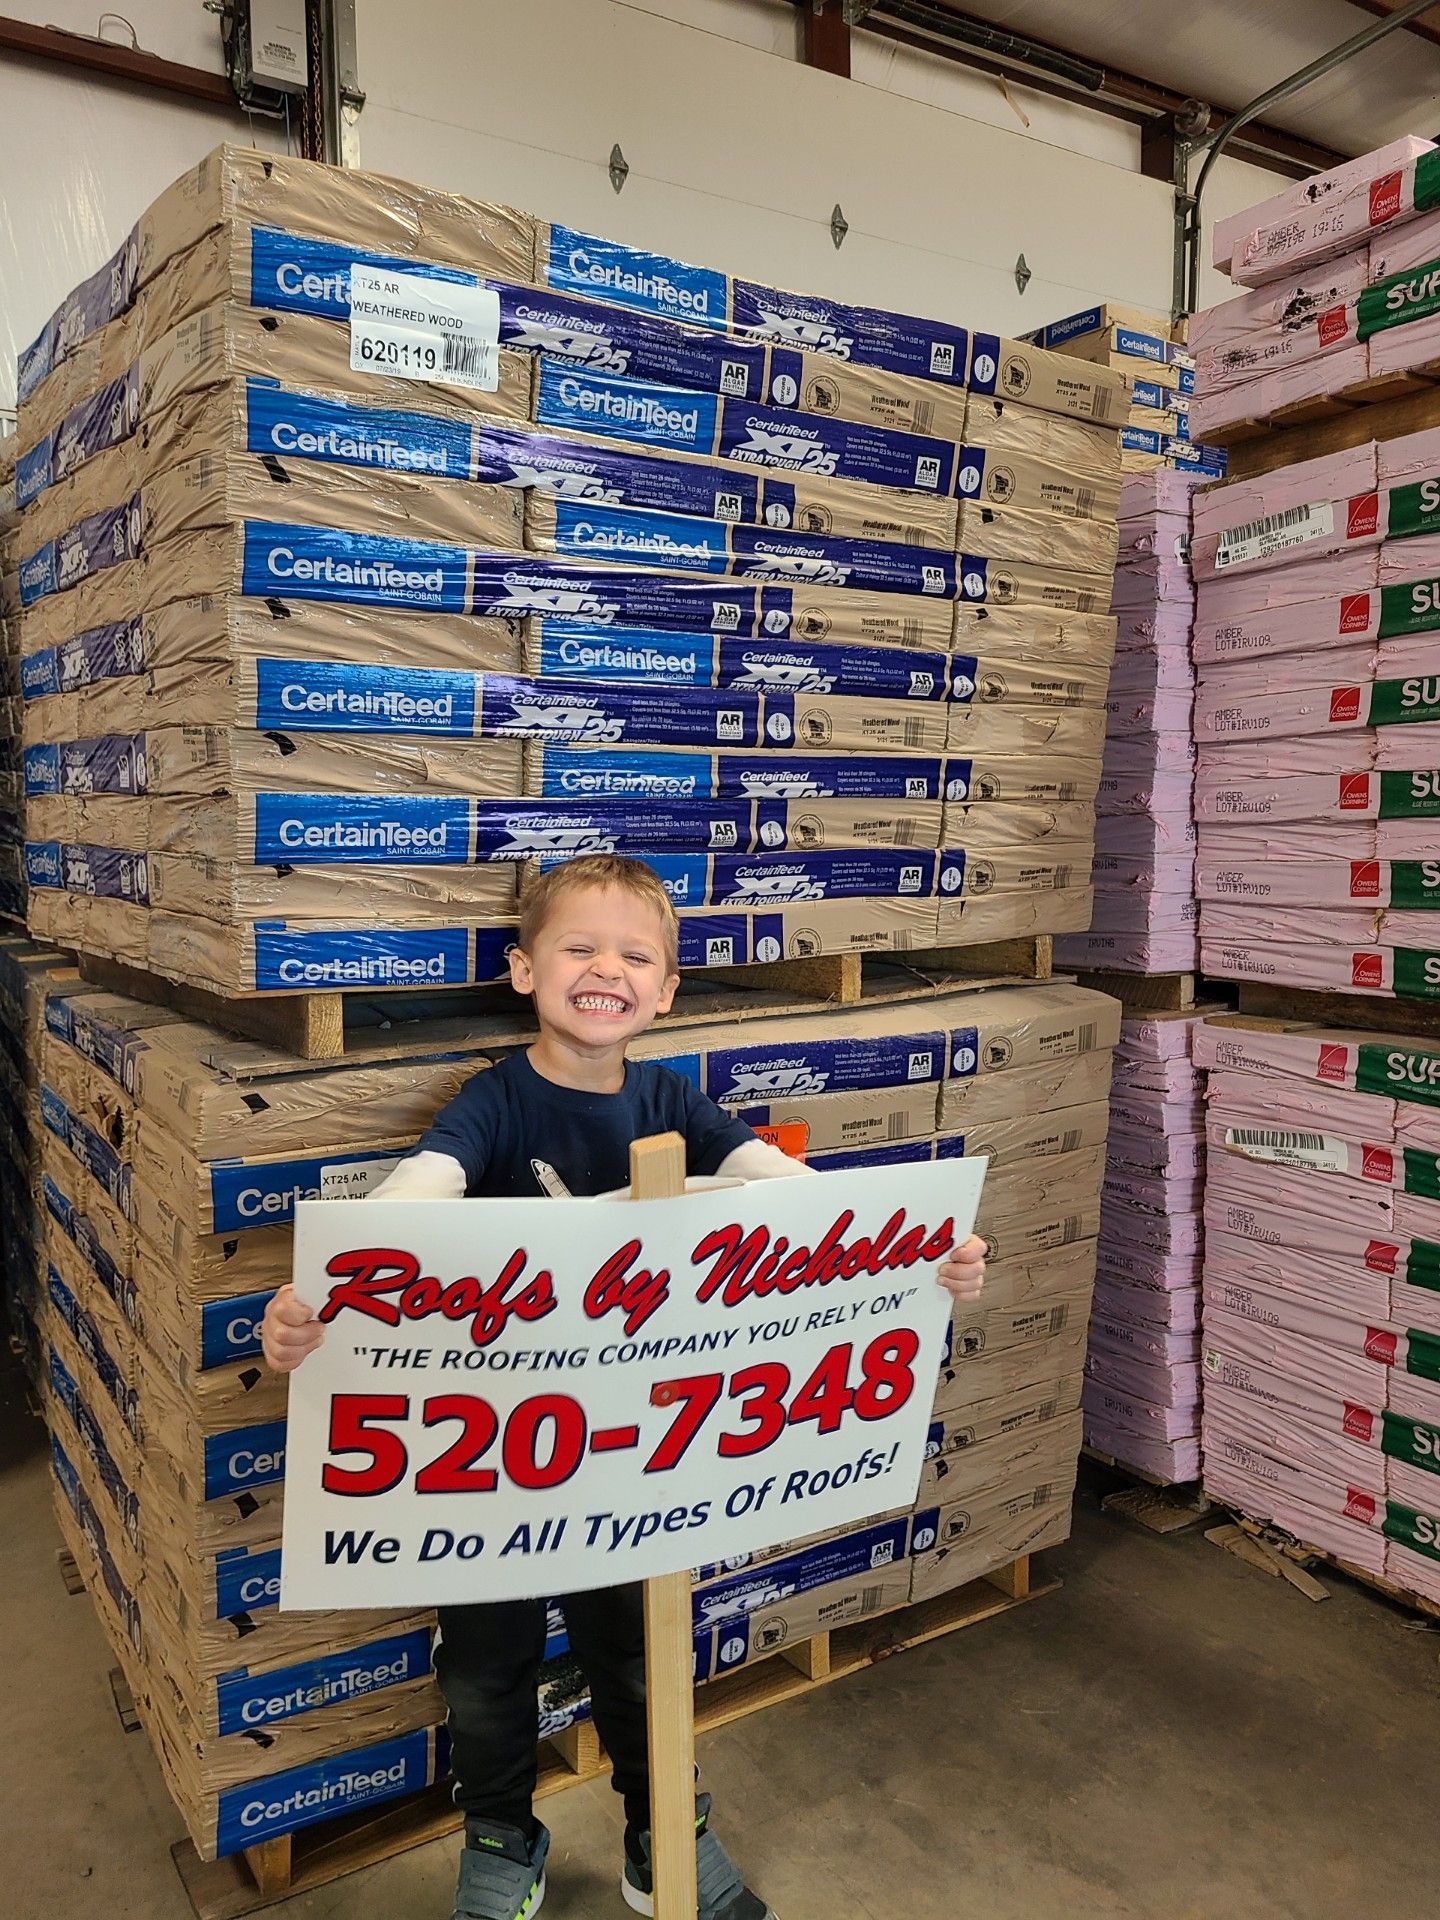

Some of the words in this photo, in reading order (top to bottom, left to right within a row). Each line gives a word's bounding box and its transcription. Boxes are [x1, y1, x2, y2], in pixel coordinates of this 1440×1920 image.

[1372, 201, 1398, 220] CORNING
[384, 283, 400, 294] AR
[569, 251, 708, 313] CertainTeed
[353, 300, 425, 322] WEATHERED
[428, 314, 463, 328] WOOD
[757, 300, 830, 324] CertainTeed
[515, 306, 605, 335] CertainTeed
[362, 338, 435, 369] 620119
[934, 347, 952, 359] AR
[1121, 338, 1160, 355] CertainTeed
[724, 363, 746, 380] AR
[559, 378, 698, 433] CertainTeed
[745, 416, 818, 439] CertainTeed
[271, 422, 447, 471] CertainTeed
[507, 449, 597, 475] CertainTeed
[729, 448, 765, 464] EXTRA
[763, 455, 802, 471] TOUGH
[919, 460, 937, 473] AR
[718, 496, 739, 510] AR
[1349, 522, 1376, 534] CORNING
[1355, 515, 1376, 526] OWENS
[574, 523, 709, 558] CertainTeed
[754, 542, 824, 558] CertainTeed
[660, 556, 709, 566] SAINT-GOBAIN
[267, 548, 443, 592] CertainTeed
[924, 570, 942, 581] AR
[503, 572, 592, 591] CertainTeed
[378, 587, 442, 602] SAINT-GOBAIN
[717, 605, 737, 618] AR
[1342, 620, 1367, 629] CORNING
[1215, 627, 1243, 640] AMBER
[560, 639, 696, 674] CertainTeed
[741, 652, 813, 666] CertainTeed
[914, 673, 931, 685] AR
[281, 684, 452, 717] CertainTeed
[510, 693, 598, 708] CertainTeed
[1215, 709, 1243, 721] AMBER
[1332, 710, 1357, 719] CORNING
[1337, 705, 1358, 713] OWENS
[719, 713, 741, 727] AR
[886, 718, 900, 726] Wood
[561, 770, 696, 795] CertainTeed
[740, 771, 810, 783] CertainTeed
[908, 780, 925, 792] AR
[1216, 792, 1244, 802] AMBER
[505, 816, 593, 828] CertainTeed
[714, 822, 735, 836] AR
[279, 819, 447, 847] CertainTeed
[386, 846, 446, 855] SAINT-GOBAIN
[735, 864, 806, 877] CertainTeed
[903, 869, 920, 881] AR
[1216, 872, 1244, 883] AMBER
[709, 938, 730, 953] AR
[279, 953, 445, 982] CertainTeed
[1354, 976, 1381, 984] CORNING
[1216, 1042, 1244, 1055] AMBER
[730, 1056, 805, 1075] CertainTeed
[911, 1053, 930, 1067] AR
[1320, 1069, 1345, 1078] CORNING
[750, 1089, 790, 1100] TOUGH
[867, 1117, 883, 1127] Wood
[322, 1174, 349, 1186] XT25
[352, 1172, 368, 1182] AR
[1365, 1166, 1391, 1178] CORNING
[1227, 1206, 1255, 1225] AMBER
[318, 1248, 558, 1347] Roofs
[584, 1238, 669, 1337] by
[691, 1208, 955, 1307] Nicholas
[1225, 1287, 1253, 1303] AMBER
[441, 1348, 587, 1372] ROOFING
[598, 1328, 739, 1364] COMPANY
[748, 1315, 800, 1344] YOU
[805, 1300, 871, 1332] RELY
[1223, 1362, 1251, 1381] AMBER
[321, 1328, 920, 1497] 520-7348
[324, 1530, 401, 1565] We
[418, 1528, 485, 1563] Do
[498, 1518, 568, 1558] All
[584, 1500, 712, 1548] Types
[725, 1476, 776, 1519] Of
[781, 1441, 901, 1506] Roofs!
[873, 1542, 892, 1557] AR
[701, 1576, 773, 1609] CertainTeed
[241, 1653, 409, 1723] CertainTeed
[349, 1672, 409, 1698] SAINT-GOBAIN
[241, 1758, 406, 1827] CertainTeed
[346, 1779, 406, 1803] SAINT-GOBAIN
